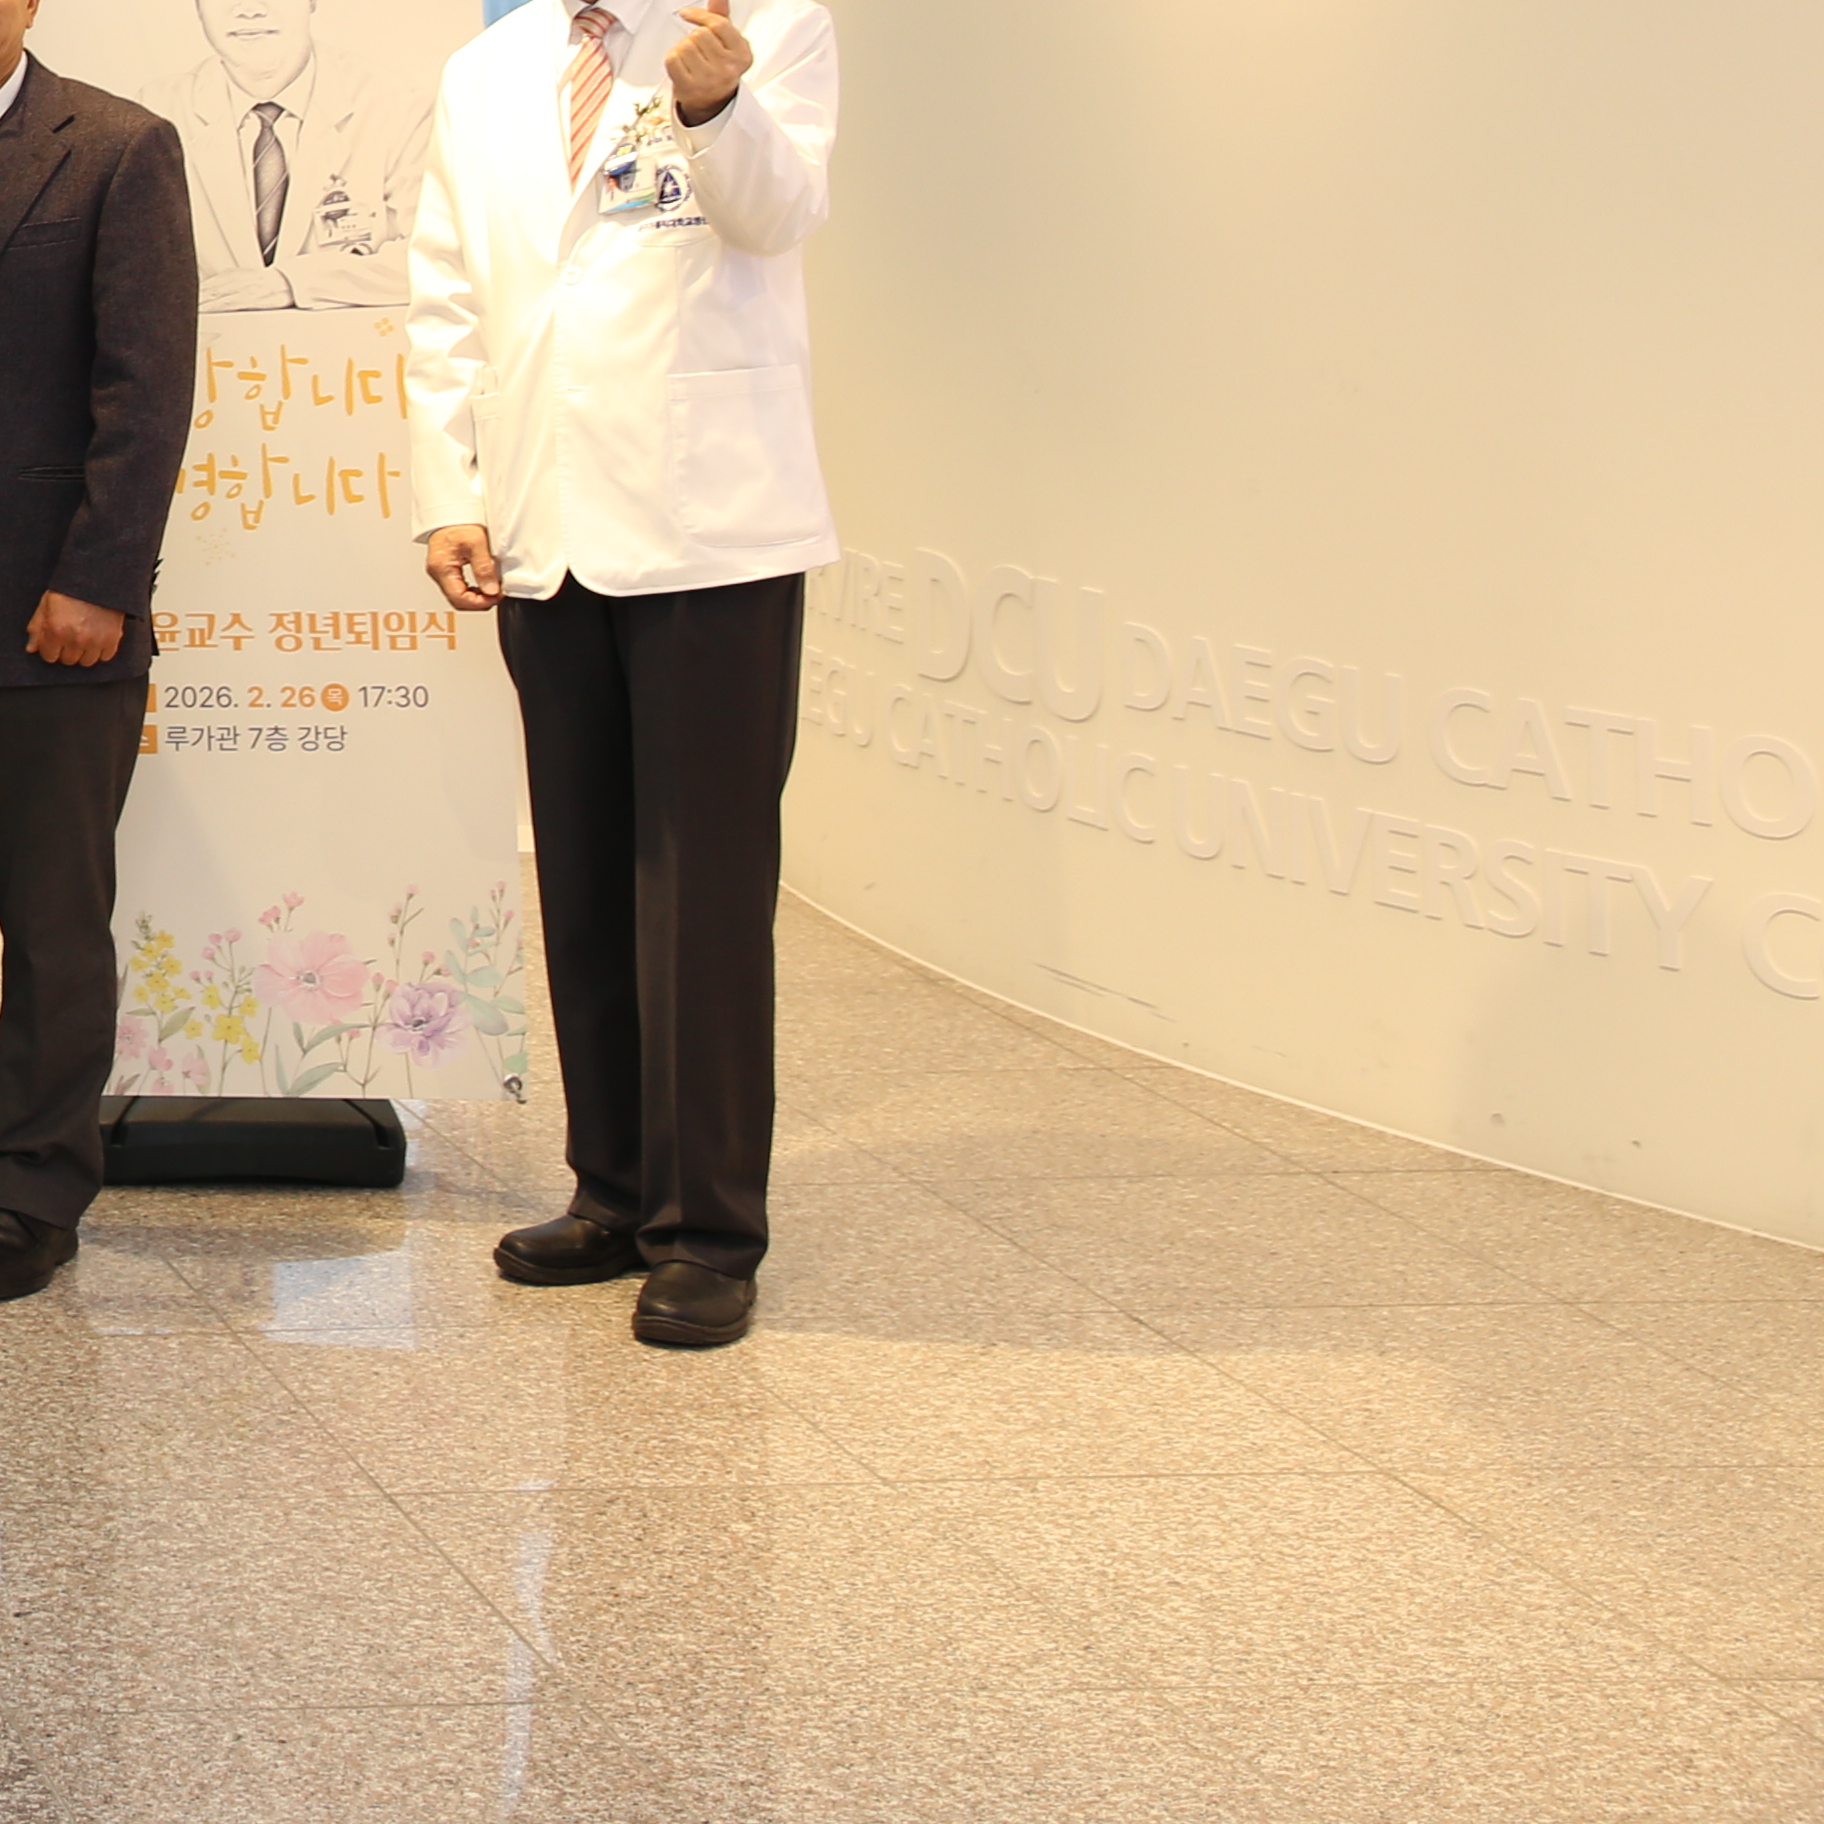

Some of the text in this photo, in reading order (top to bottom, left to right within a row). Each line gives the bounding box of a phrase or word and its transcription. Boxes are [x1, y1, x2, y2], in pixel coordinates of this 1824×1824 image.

[268, 609, 457, 653] 정년퇴임식
[914, 546, 1106, 725] DCU
[1121, 620, 1404, 766] DAEGU
[165, 686, 238, 708] 2026.
[248, 686, 271, 708] 2.
[281, 687, 315, 707] 26
[359, 686, 428, 707] 17:30
[165, 726, 239, 751] 루가관
[249, 726, 288, 751] 7층
[299, 726, 347, 751] 강당
[887, 681, 1157, 846] CATHOLIC
[1173, 762, 1714, 973] UNIVERSITY
